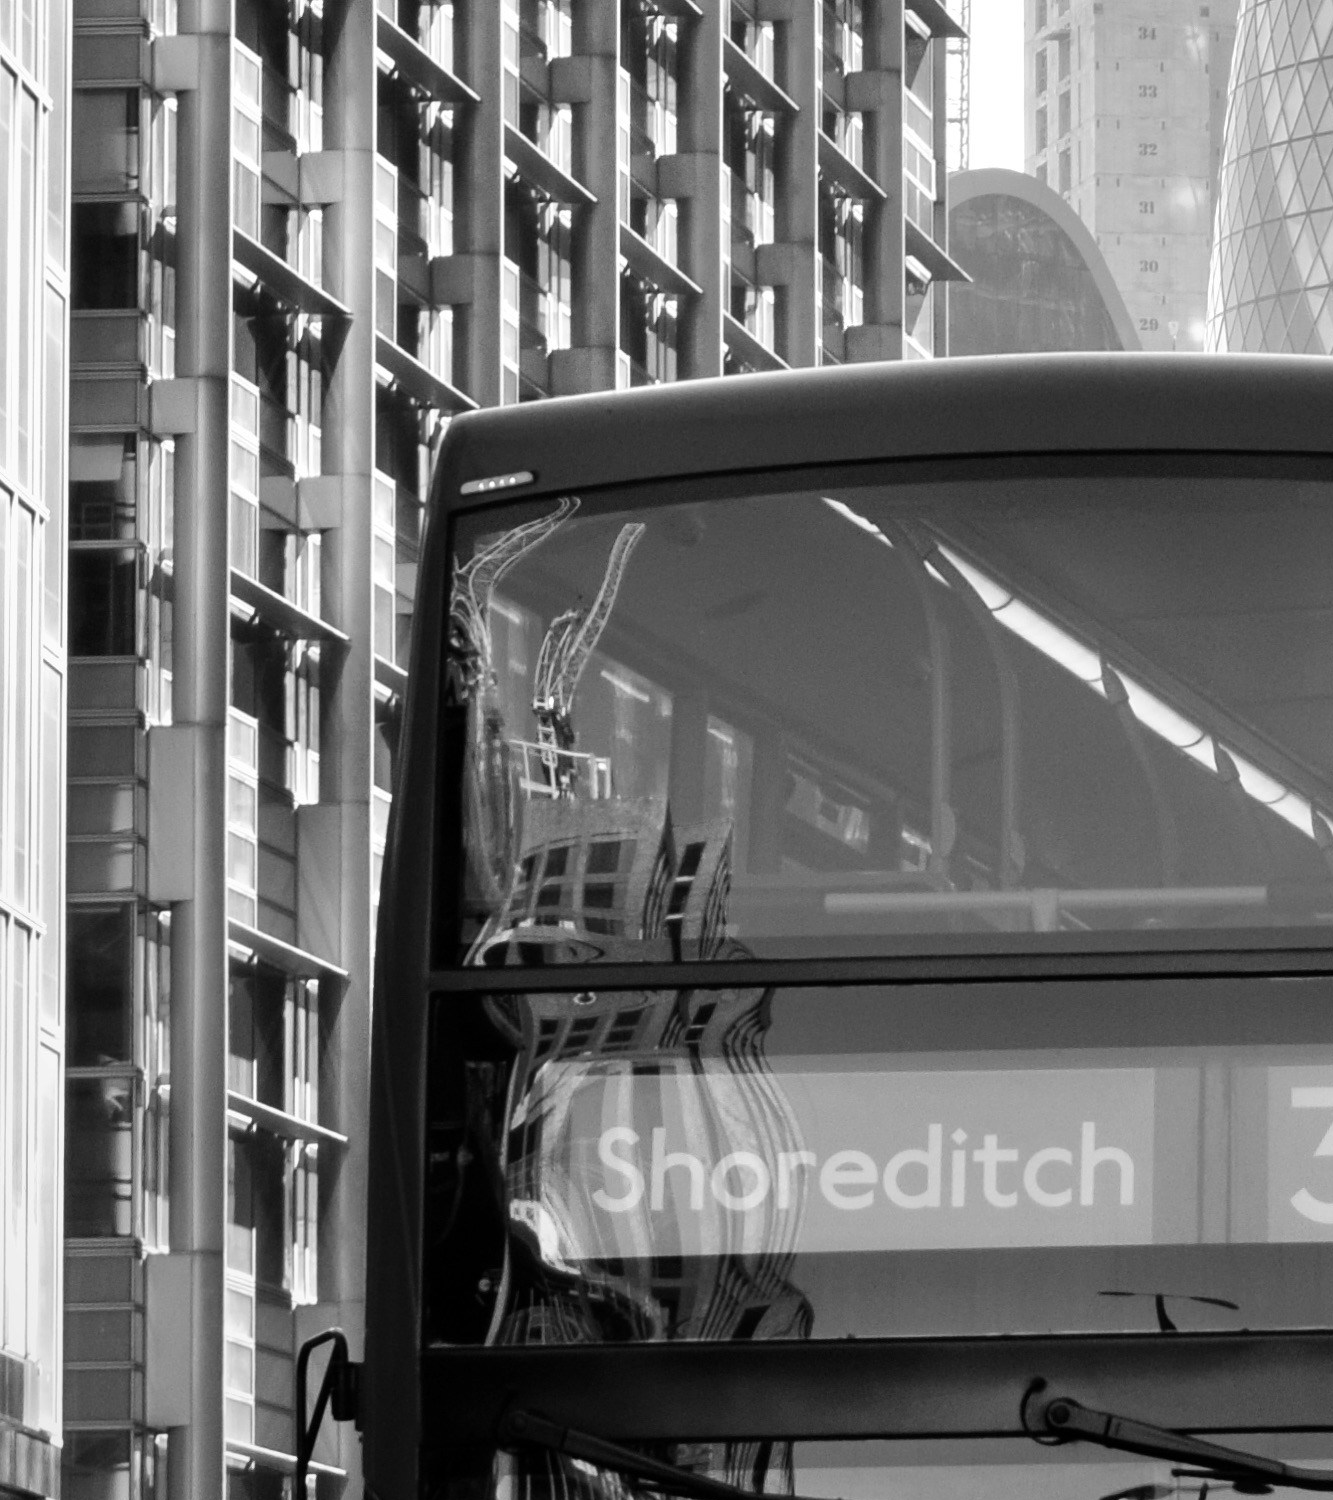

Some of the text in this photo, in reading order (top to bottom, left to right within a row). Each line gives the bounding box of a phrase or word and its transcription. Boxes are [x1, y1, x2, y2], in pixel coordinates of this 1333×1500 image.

[1138, 27, 1157, 40] 34
[1138, 85, 1158, 98] 33
[1138, 143, 1158, 156] 32
[1138, 201, 1155, 214] 31
[1139, 259, 1159, 273] 30
[1139, 318, 1159, 331] 29
[591, 1121, 1135, 1213] Shoreditch
